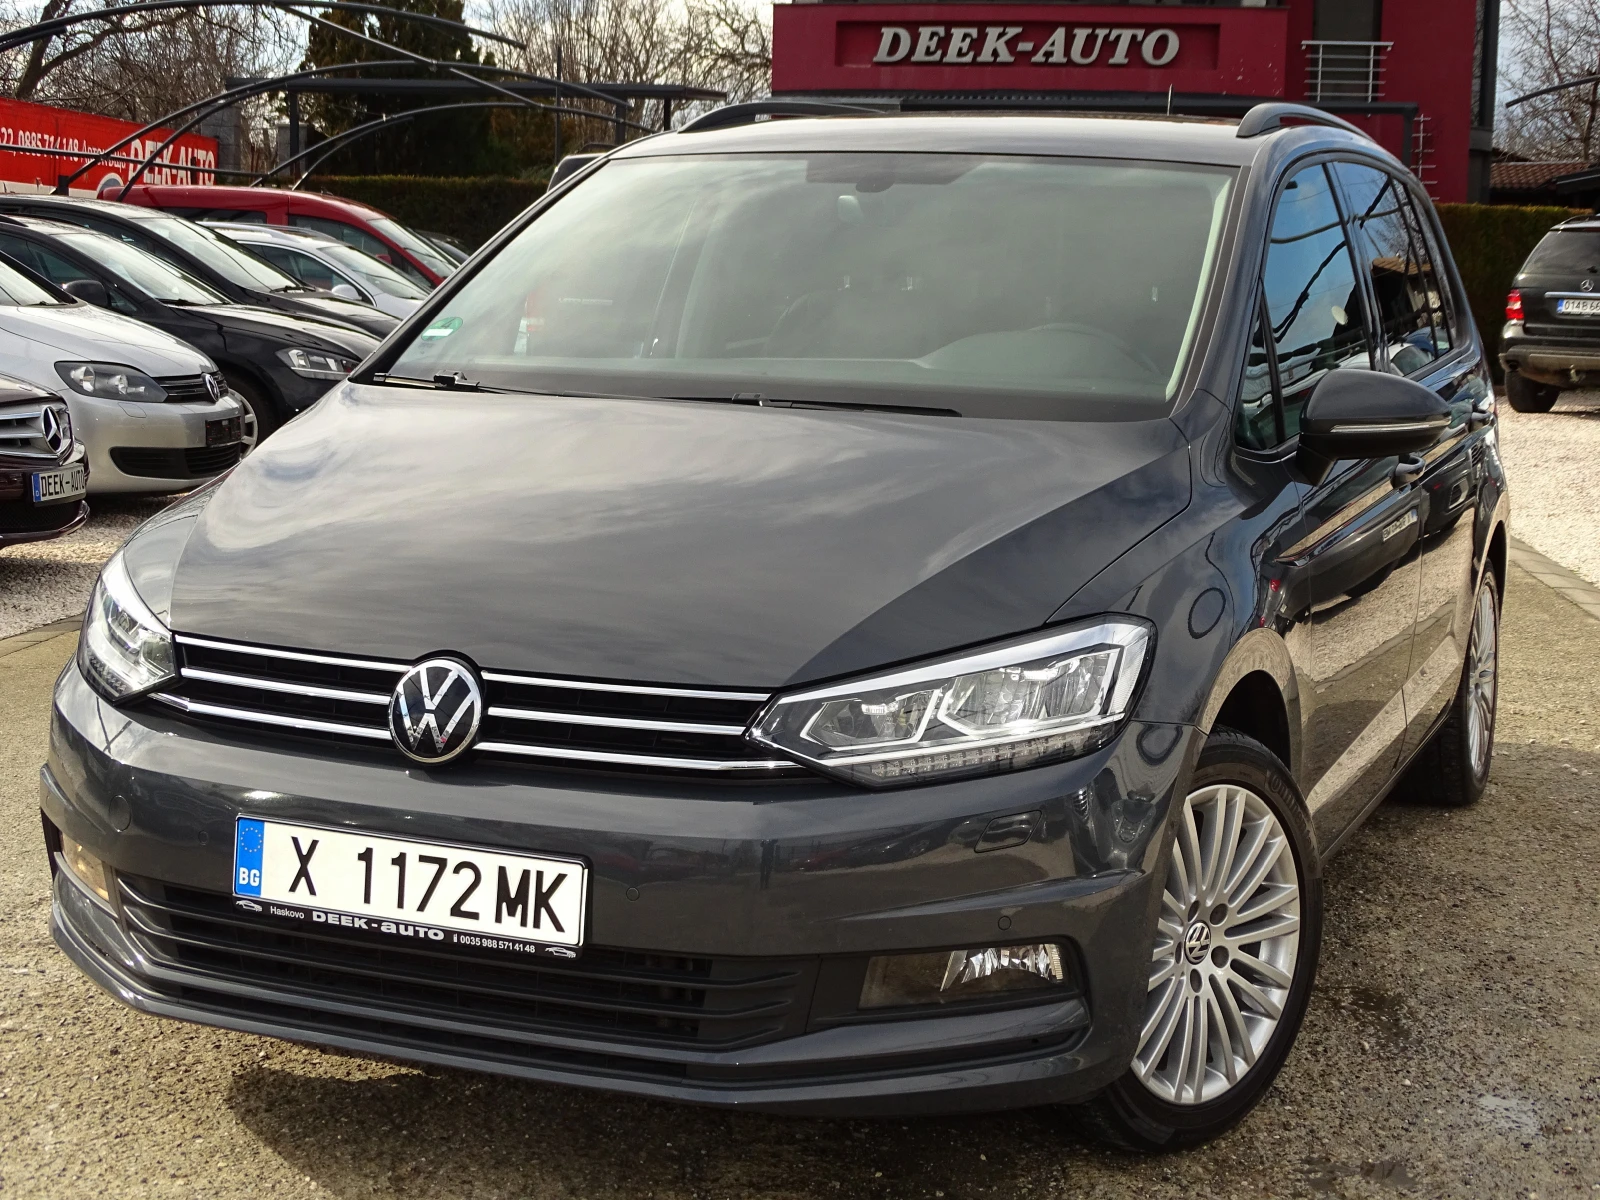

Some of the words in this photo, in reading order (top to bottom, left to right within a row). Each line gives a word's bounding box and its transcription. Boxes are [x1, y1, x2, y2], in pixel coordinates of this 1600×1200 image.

[873, 26, 1180, 65] DEEK-AUTO
[0, 127, 16, 157] 22,
[18, 130, 42, 157] 0885
[62, 137, 79, 162] 148
[239, 867, 260, 886] BG
[289, 836, 319, 896] X
[357, 847, 482, 920] 1172
[495, 865, 568, 933] MK
[270, 906, 304, 919] Haskovo
[460, 935, 480, 946] 0035
[483, 938, 497, 949] 988
[499, 940, 513, 950] 571
